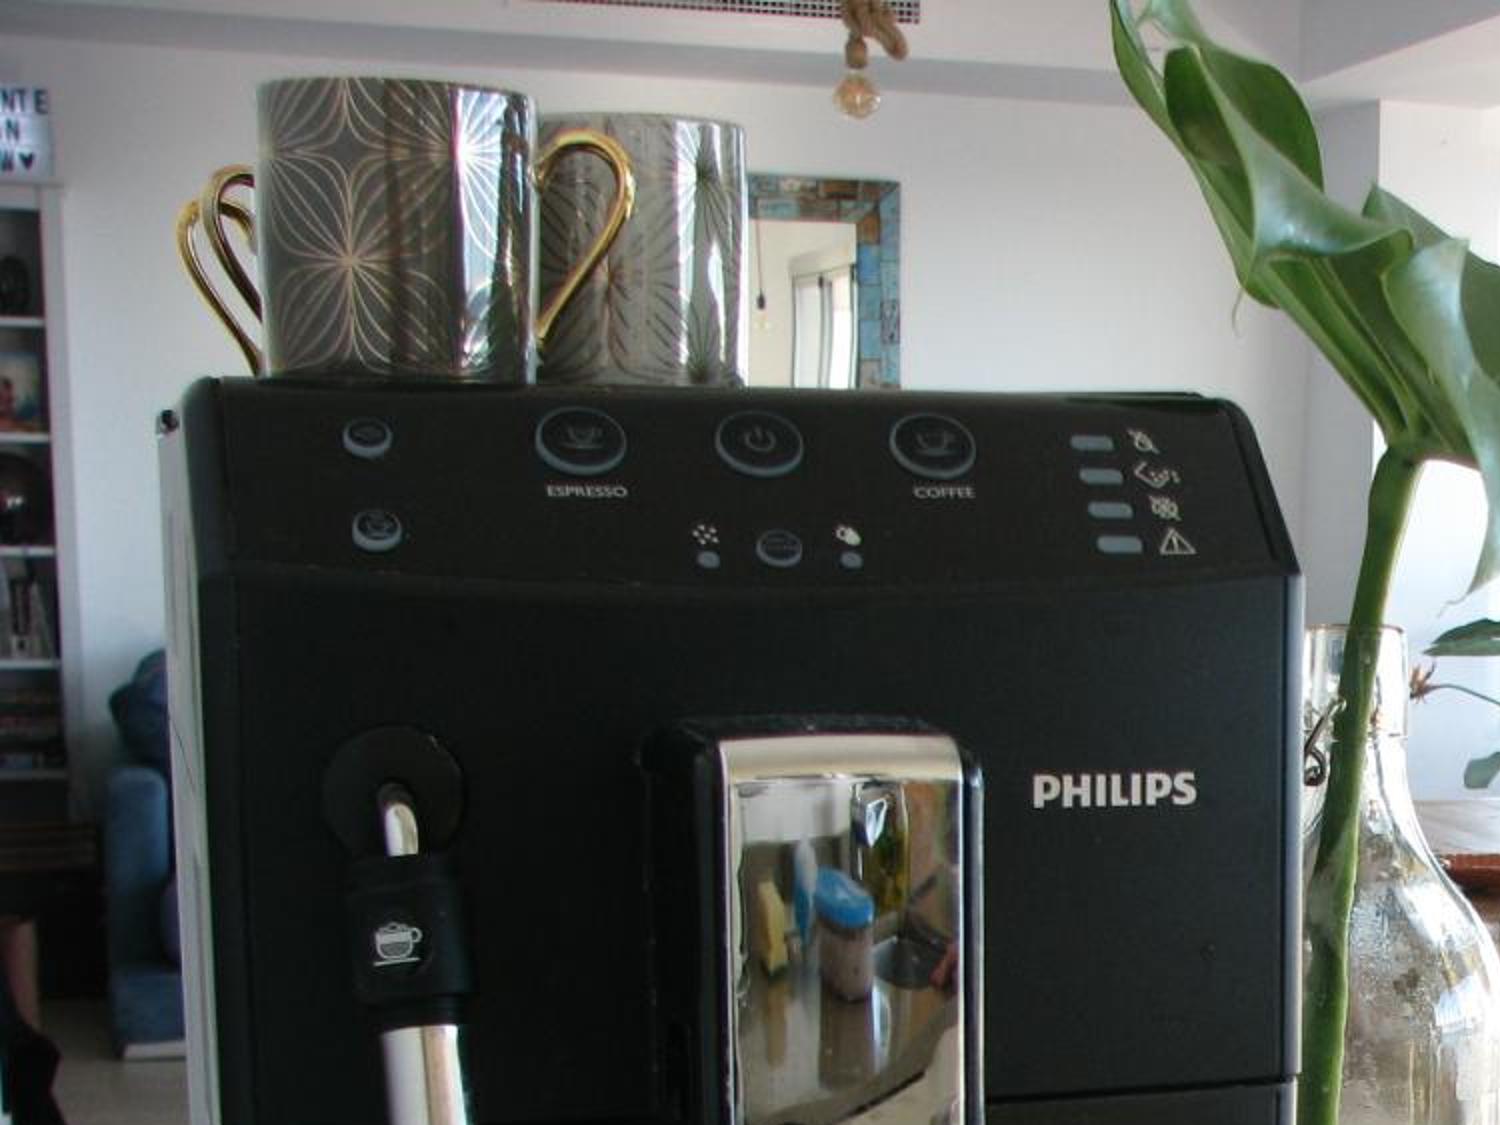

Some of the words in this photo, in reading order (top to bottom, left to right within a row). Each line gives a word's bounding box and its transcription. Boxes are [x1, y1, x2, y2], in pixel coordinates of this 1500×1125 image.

[545, 484, 628, 499] ESPRESSO
[912, 485, 976, 499] COFFEE
[1031, 771, 1198, 809] PHILIPS
